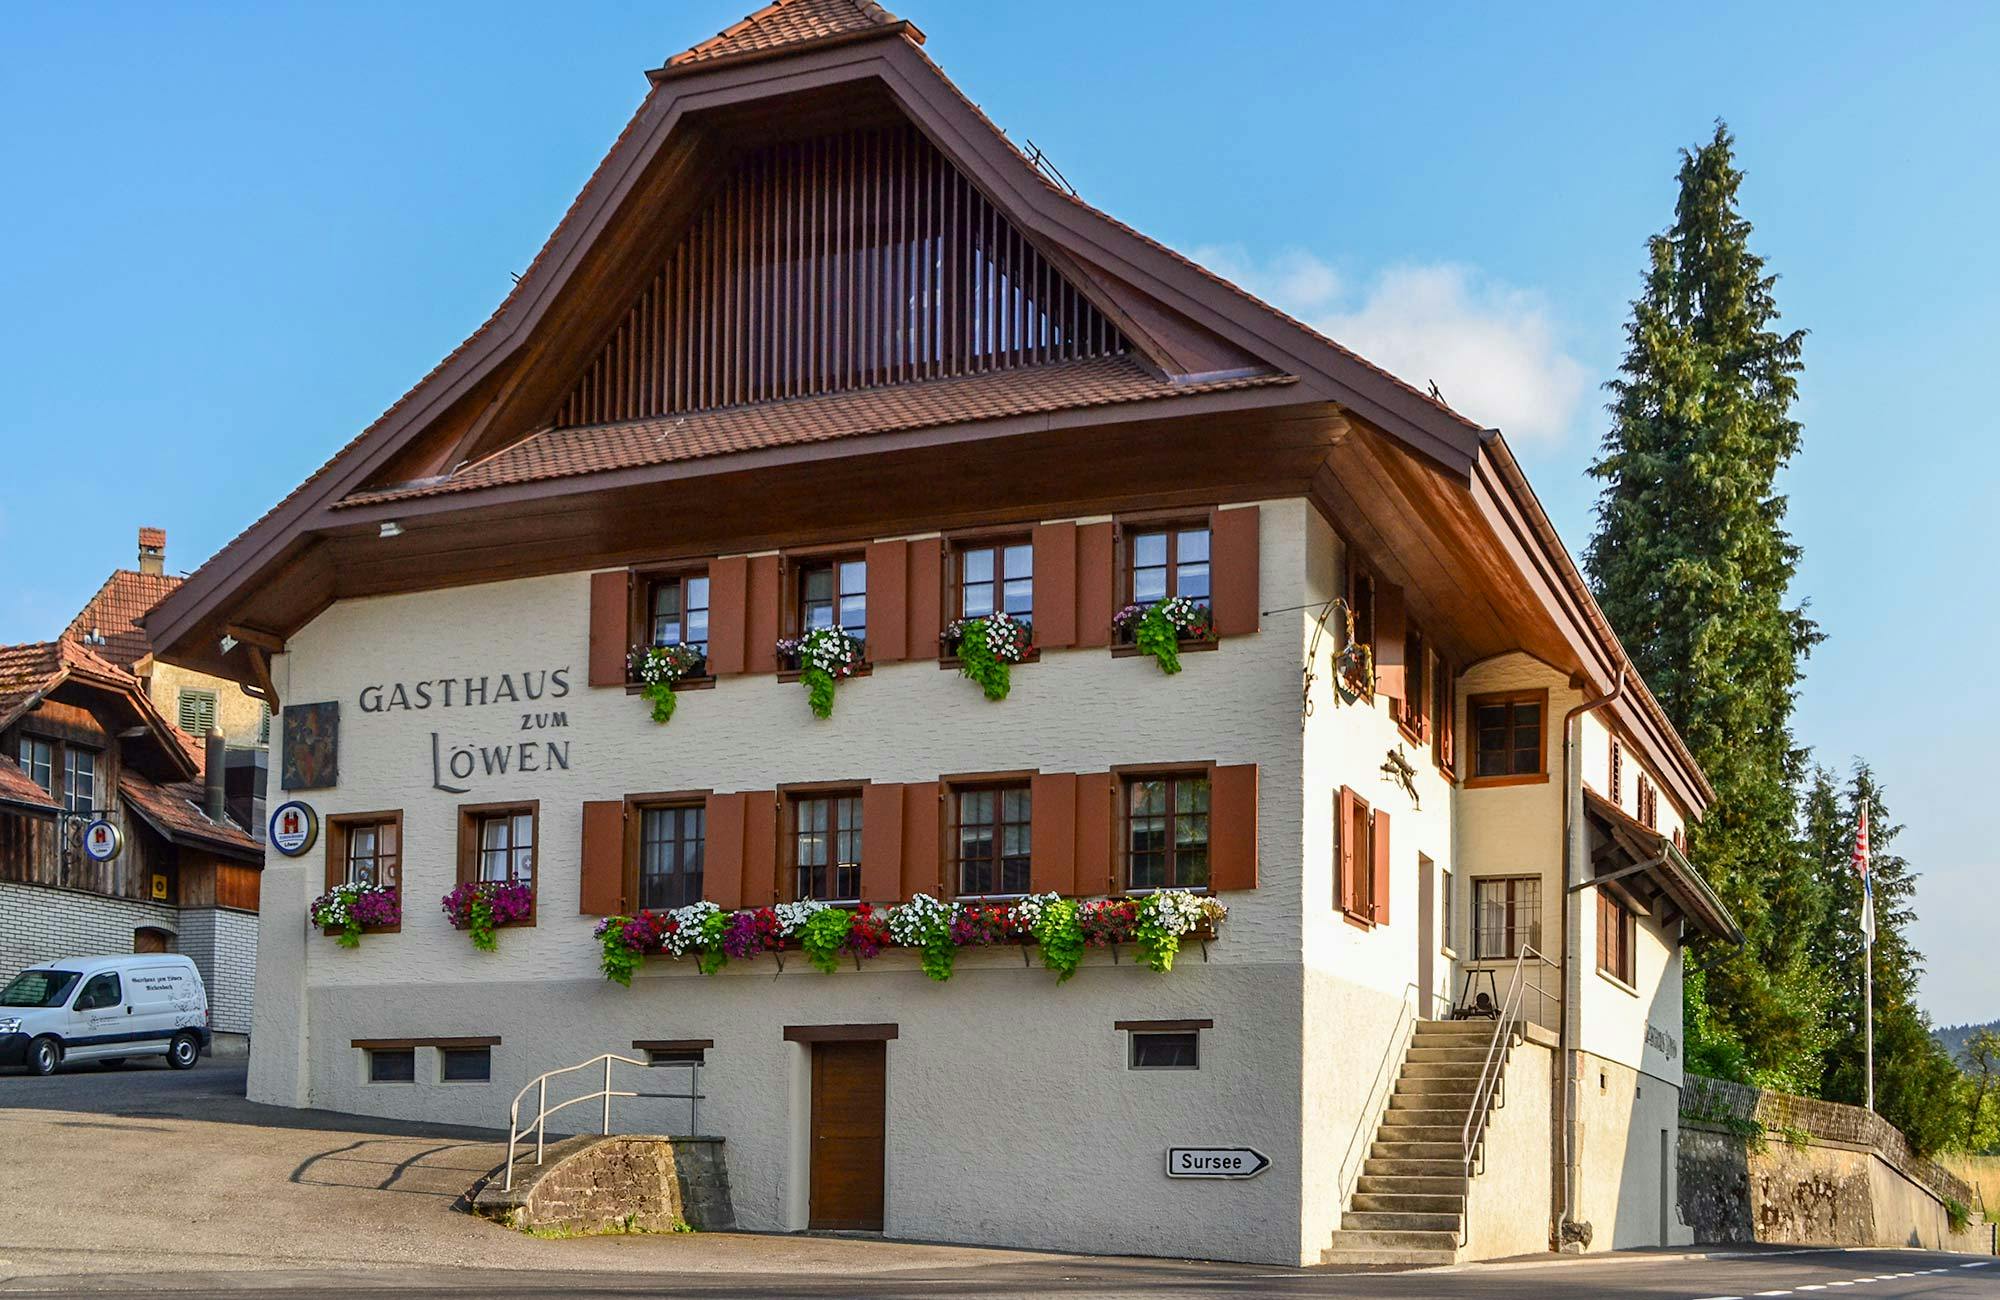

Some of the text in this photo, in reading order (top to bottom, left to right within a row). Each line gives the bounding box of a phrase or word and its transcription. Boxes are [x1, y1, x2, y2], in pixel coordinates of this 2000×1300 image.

[359, 666, 570, 713] GASTHAUS
[521, 711, 569, 730] ZUM
[1181, 1153, 1242, 1169] Sursee
